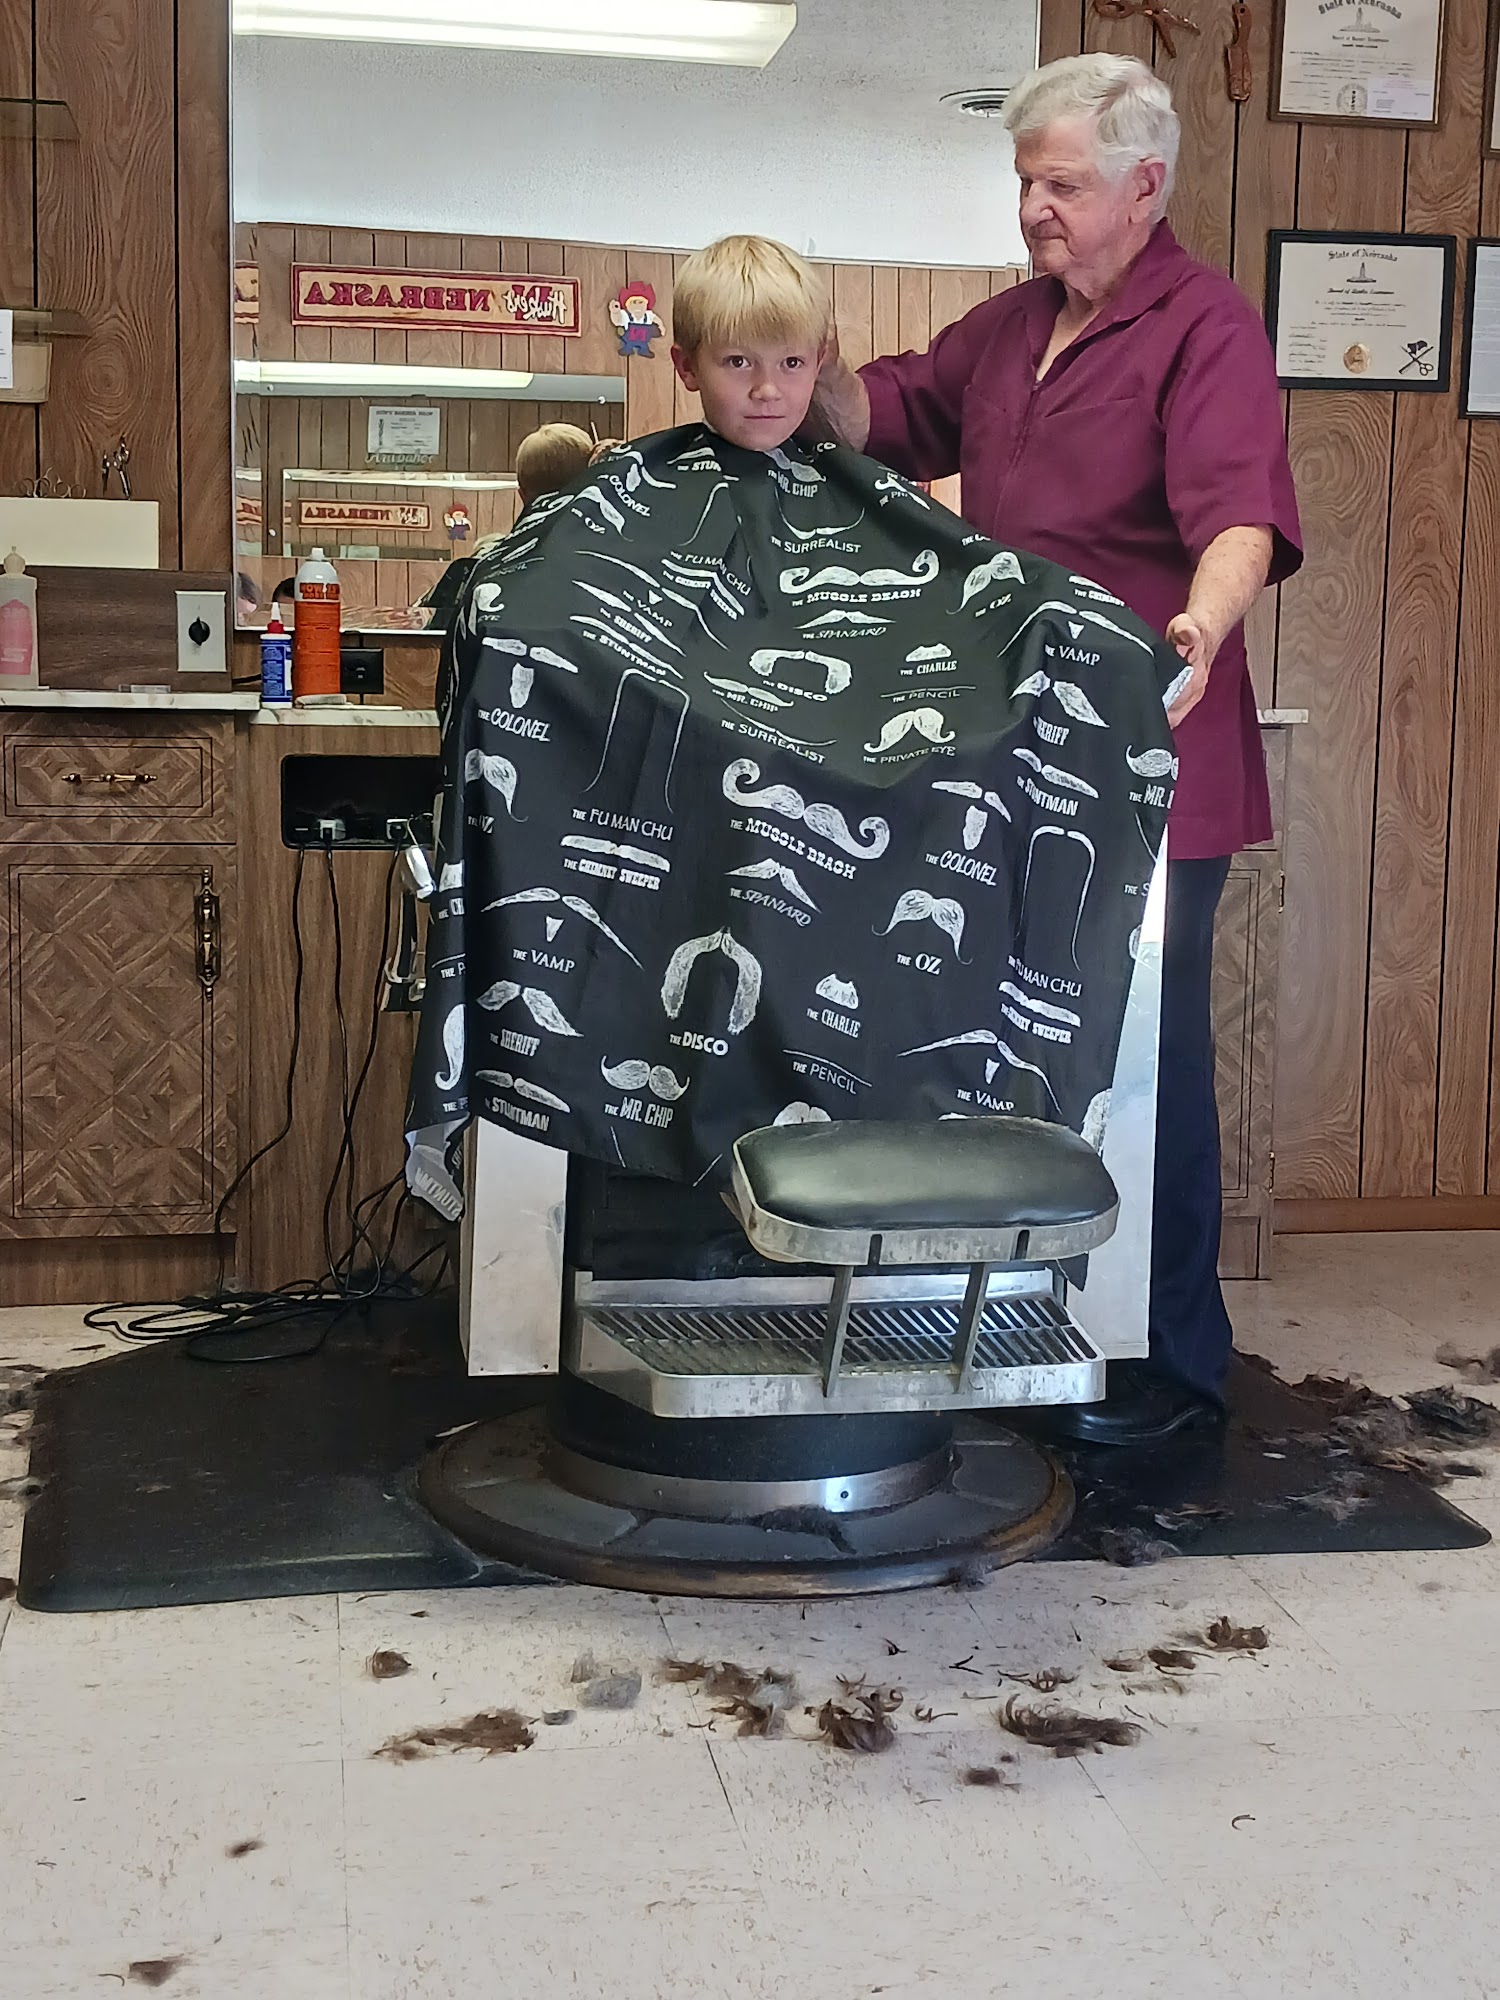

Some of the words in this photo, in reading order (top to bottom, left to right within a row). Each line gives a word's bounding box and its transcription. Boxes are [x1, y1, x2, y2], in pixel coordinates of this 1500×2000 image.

[1328, 251, 1350, 261] State
[609, 475, 651, 517] COLONEL
[792, 482, 818, 498] CHIP
[784, 537, 862, 554] SURREALIST
[726, 572, 751, 596] CHU
[636, 599, 673, 628] VAMP
[989, 593, 1013, 610] OZ
[599, 634, 667, 676] STUNTMAN
[916, 660, 958, 675] CHARLIE
[1059, 645, 1100, 667] VAMP
[750, 697, 779, 713] CHIP
[777, 683, 828, 702] DISCO
[909, 689, 961, 700] PENCIL
[490, 707, 551, 742] COLONEL
[738, 723, 826, 765] SURREALIST
[880, 747, 930, 764] PRIVATE
[931, 745, 956, 757] EYE
[1129, 791, 1142, 803] THE
[1143, 783, 1165, 808] MR.
[572, 808, 587, 821] THE
[589, 808, 609, 826] FU
[611, 815, 640, 834] MAN
[641, 821, 674, 842] CHU
[730, 819, 743, 831] THE
[745, 817, 805, 856] MUSCLE
[806, 846, 857, 880] BEACH
[564, 858, 578, 871] THE
[619, 869, 661, 891] SWEEPER
[925, 853, 939, 865] THE
[939, 850, 997, 886] COLONEL
[1124, 884, 1139, 896] THE
[741, 889, 812, 928] SPANIARD
[441, 968, 456, 980] THE
[512, 949, 528, 962] THE
[530, 949, 575, 974] VAMP
[896, 953, 912, 967] THE
[915, 953, 943, 976] OZ
[1024, 967, 1049, 990] MAN
[1050, 978, 1082, 997] CHU
[806, 1007, 819, 1021] THE
[821, 1008, 861, 1039] CHARLIE
[1031, 1020, 1073, 1045] SWEEPER
[500, 1028, 541, 1057] SHERIFF
[669, 1034, 682, 1045] THE
[682, 1031, 729, 1056] DISCO
[793, 1061, 807, 1074] THE
[809, 1063, 857, 1095] PENCIL
[443, 1101, 458, 1113] THE
[604, 1103, 619, 1116] THE
[619, 1096, 643, 1123] MR.
[644, 1100, 674, 1129] CHIP
[957, 1089, 972, 1101] THE
[976, 1089, 1014, 1113] VAMP
[491, 1096, 550, 1132] STUNTMAN
